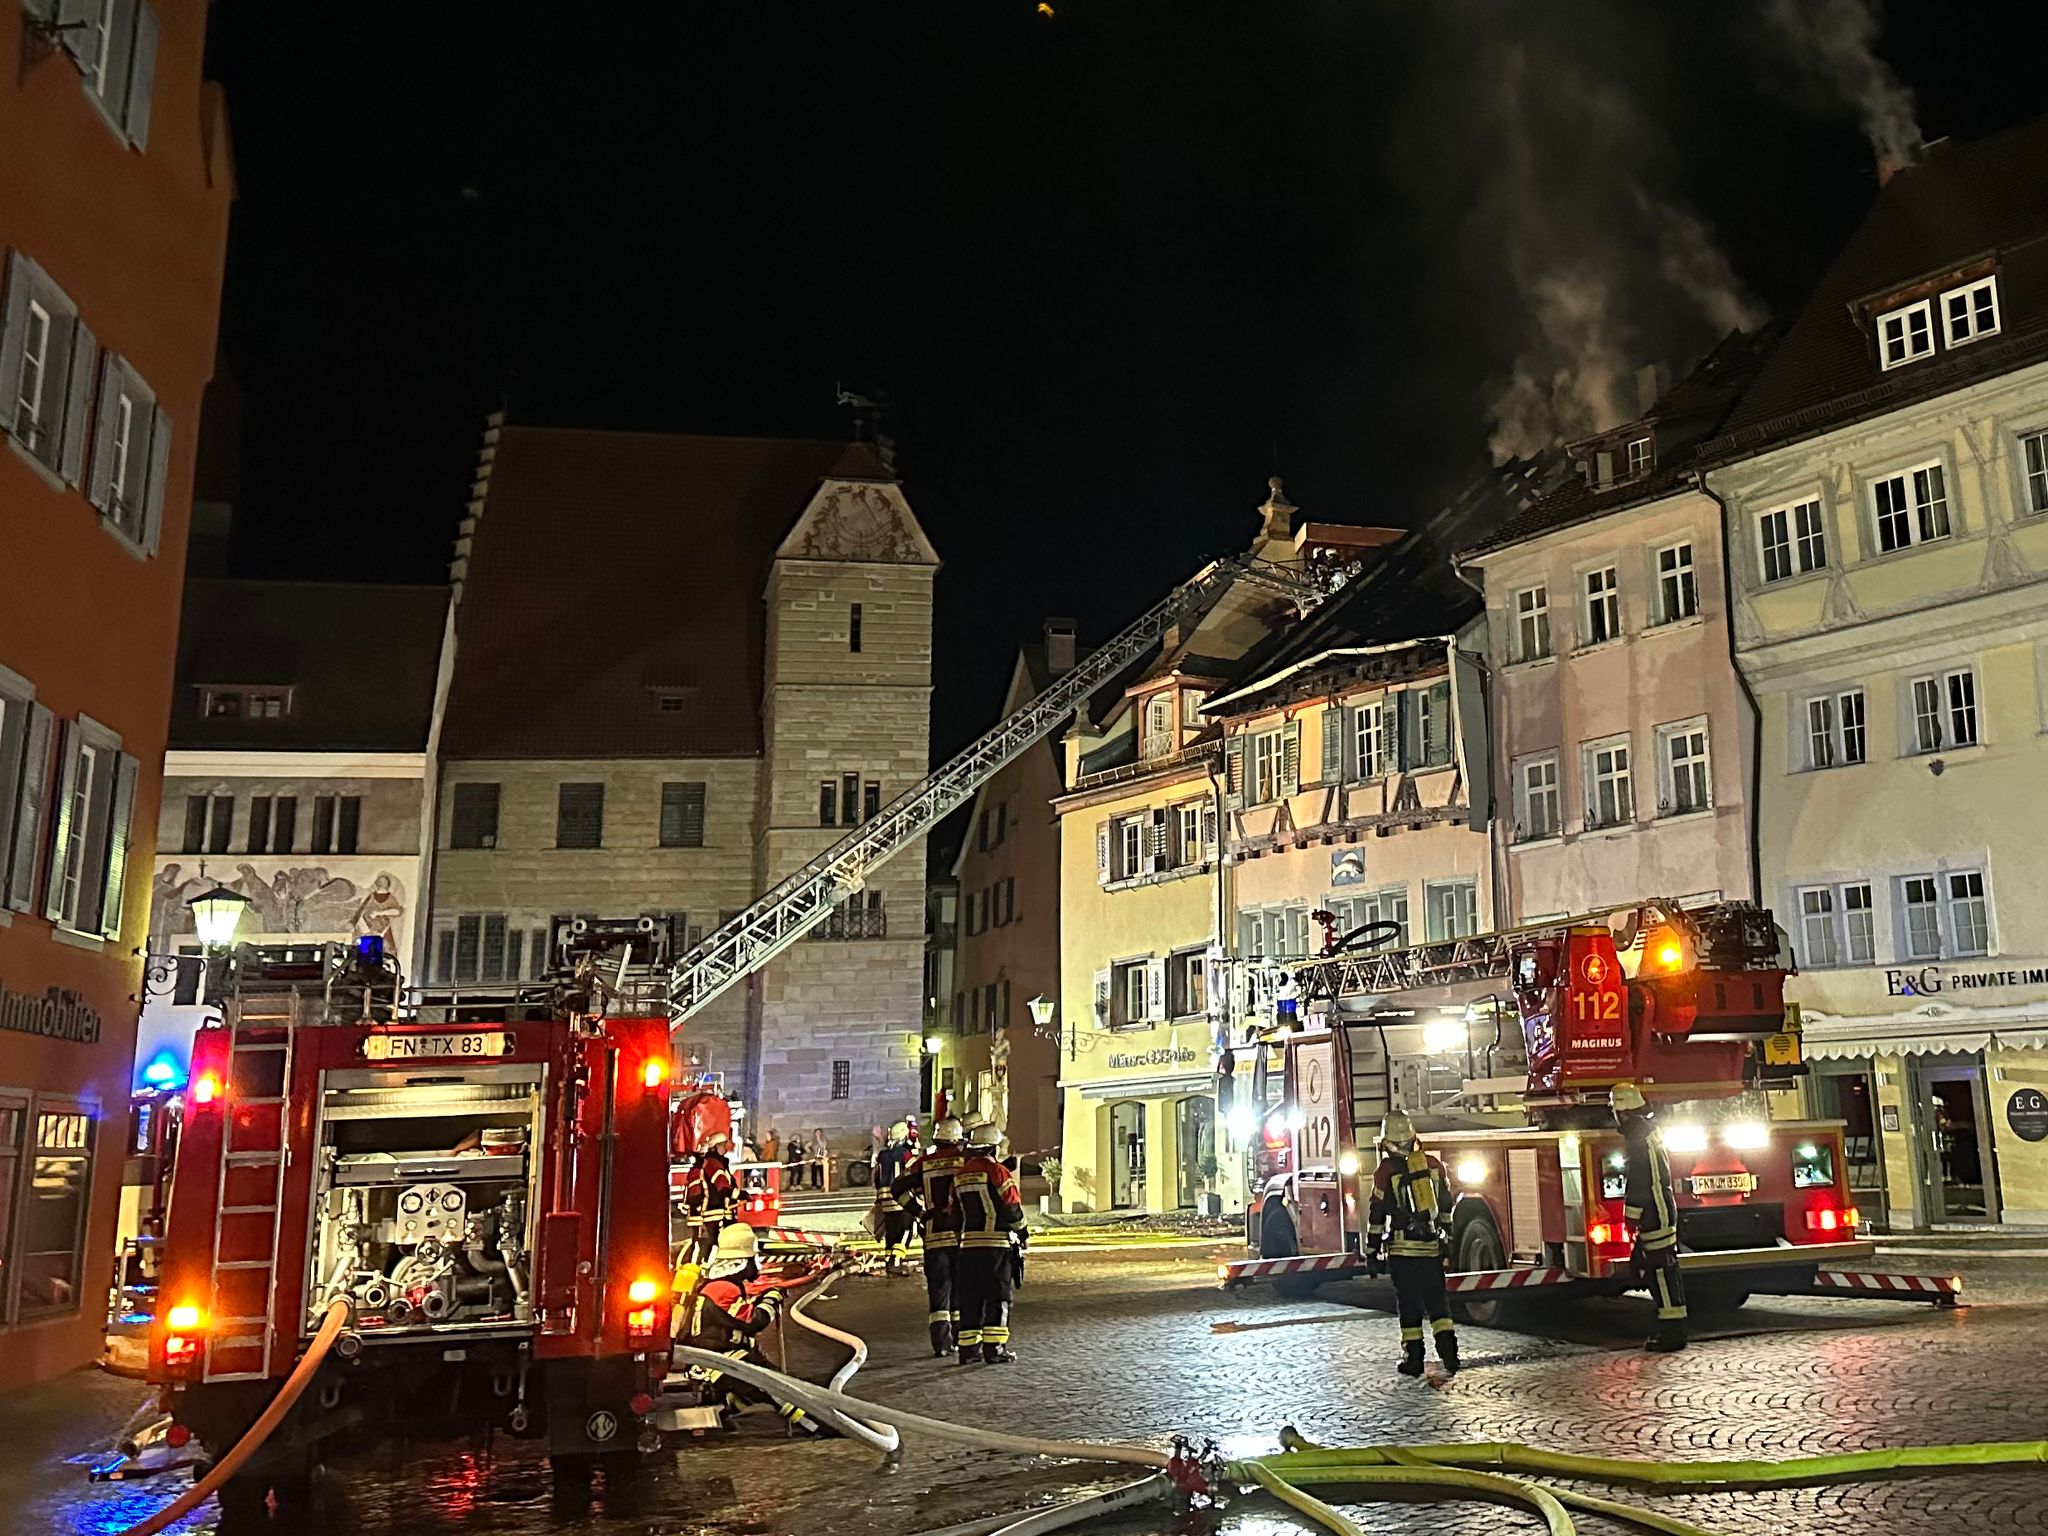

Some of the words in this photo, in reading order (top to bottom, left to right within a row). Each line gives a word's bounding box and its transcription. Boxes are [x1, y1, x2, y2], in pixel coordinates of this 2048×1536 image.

[1885, 966, 1943, 997] E&G
[1952, 971, 2017, 989] PRIVATE
[2022, 968, 2048, 985] IM
[1573, 991, 1620, 1020] 112
[391, 1038, 417, 1056] FN
[432, 1037, 453, 1055] TX
[461, 1036, 483, 1053] 83
[1571, 1038, 1622, 1049] MAGIRUS
[1303, 1115, 1332, 1158] 112
